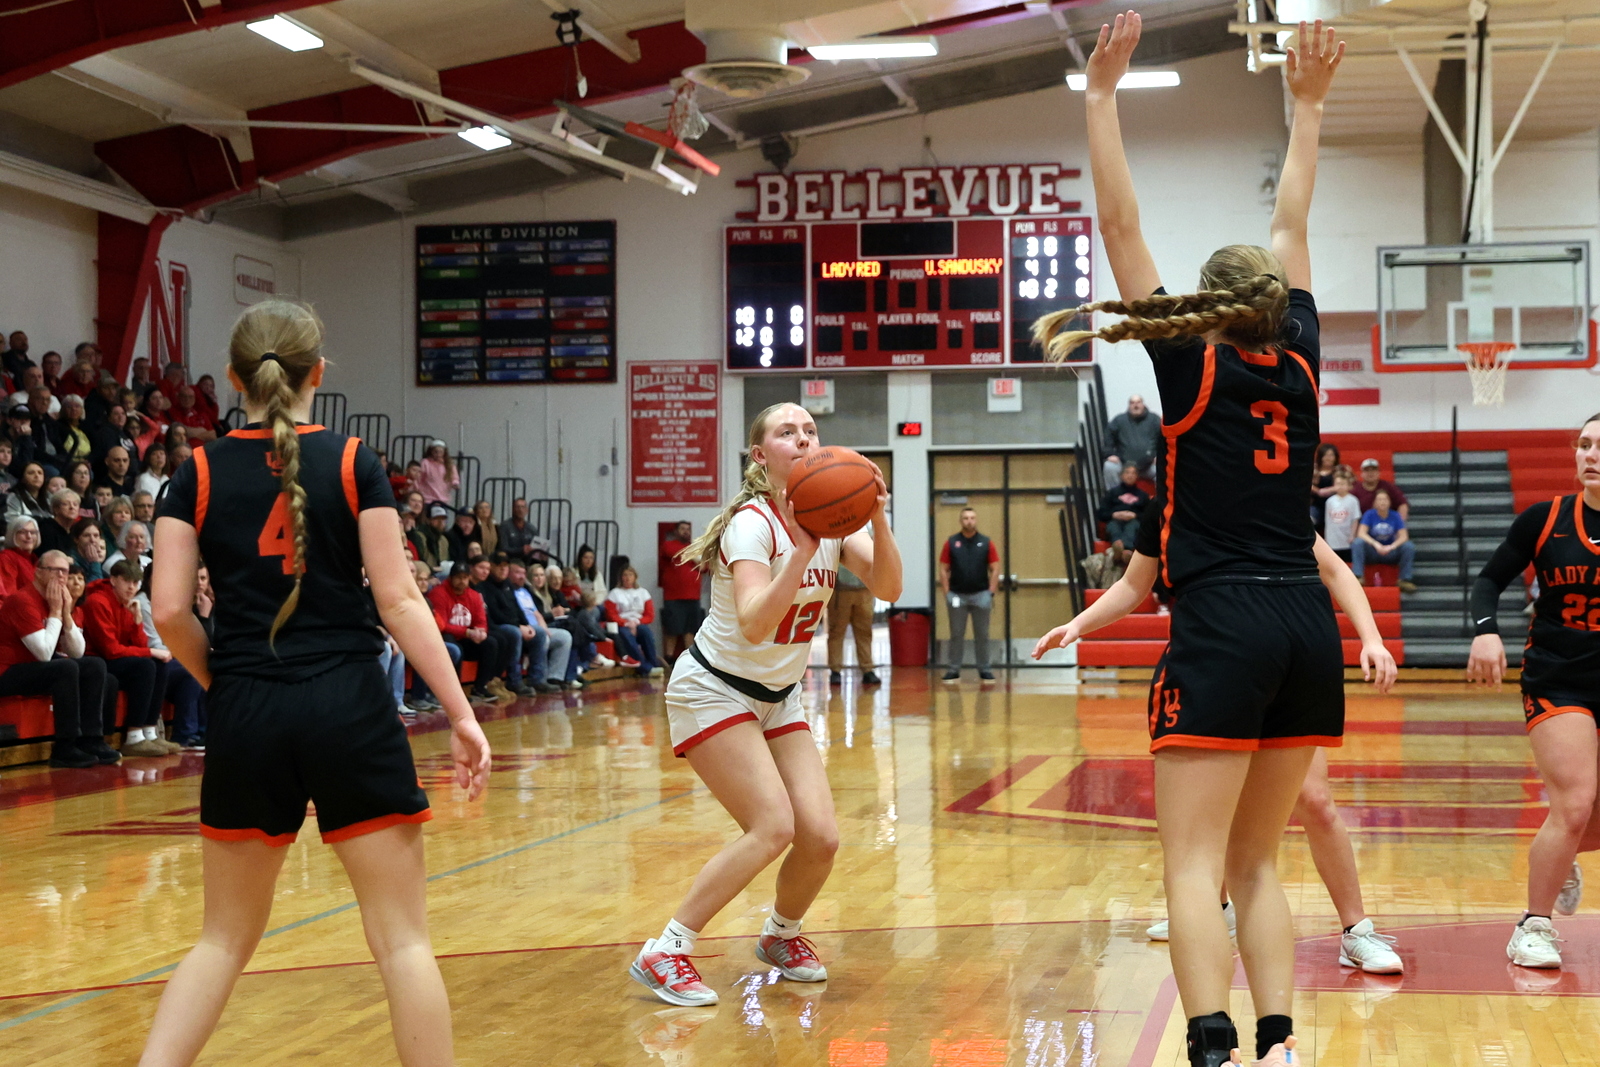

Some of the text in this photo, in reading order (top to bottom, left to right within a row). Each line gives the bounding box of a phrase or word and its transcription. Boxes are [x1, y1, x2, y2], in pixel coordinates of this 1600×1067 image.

[757, 165, 1060, 222] BELLEVUE
[452, 226, 579, 240] LAKE DIVISION
[759, 229, 773, 240] FLS
[783, 228, 798, 239] PTS
[1015, 221, 1083, 233] PLYR FLS PTS
[1026, 236, 1039, 257] 3
[1075, 235, 1089, 256] 0
[890, 268, 925, 280] PERIOD
[925, 258, 1003, 276] U.SANDUSKY
[1025, 256, 1089, 276] 4 1 9
[1043, 278, 1058, 299] 2
[1075, 277, 1089, 298] 0
[766, 307, 773, 324] 1
[790, 305, 804, 325] 0
[815, 315, 845, 326] FOULS
[878, 312, 941, 324] PLAYER FOUL
[970, 311, 1001, 323] FOULS
[736, 326, 804, 347] 12 0 0
[760, 347, 773, 367] 2
[815, 356, 846, 366] SCORE
[892, 354, 925, 365] MATCH
[970, 352, 1002, 364] SCORE
[633, 374, 716, 391] BELLEVUE HS
[633, 409, 716, 418] EXPECTATION
[1250, 399, 1290, 475] 3
[257, 490, 307, 576] 4
[1543, 565, 1589, 587] LADY
[774, 600, 824, 645] 12
